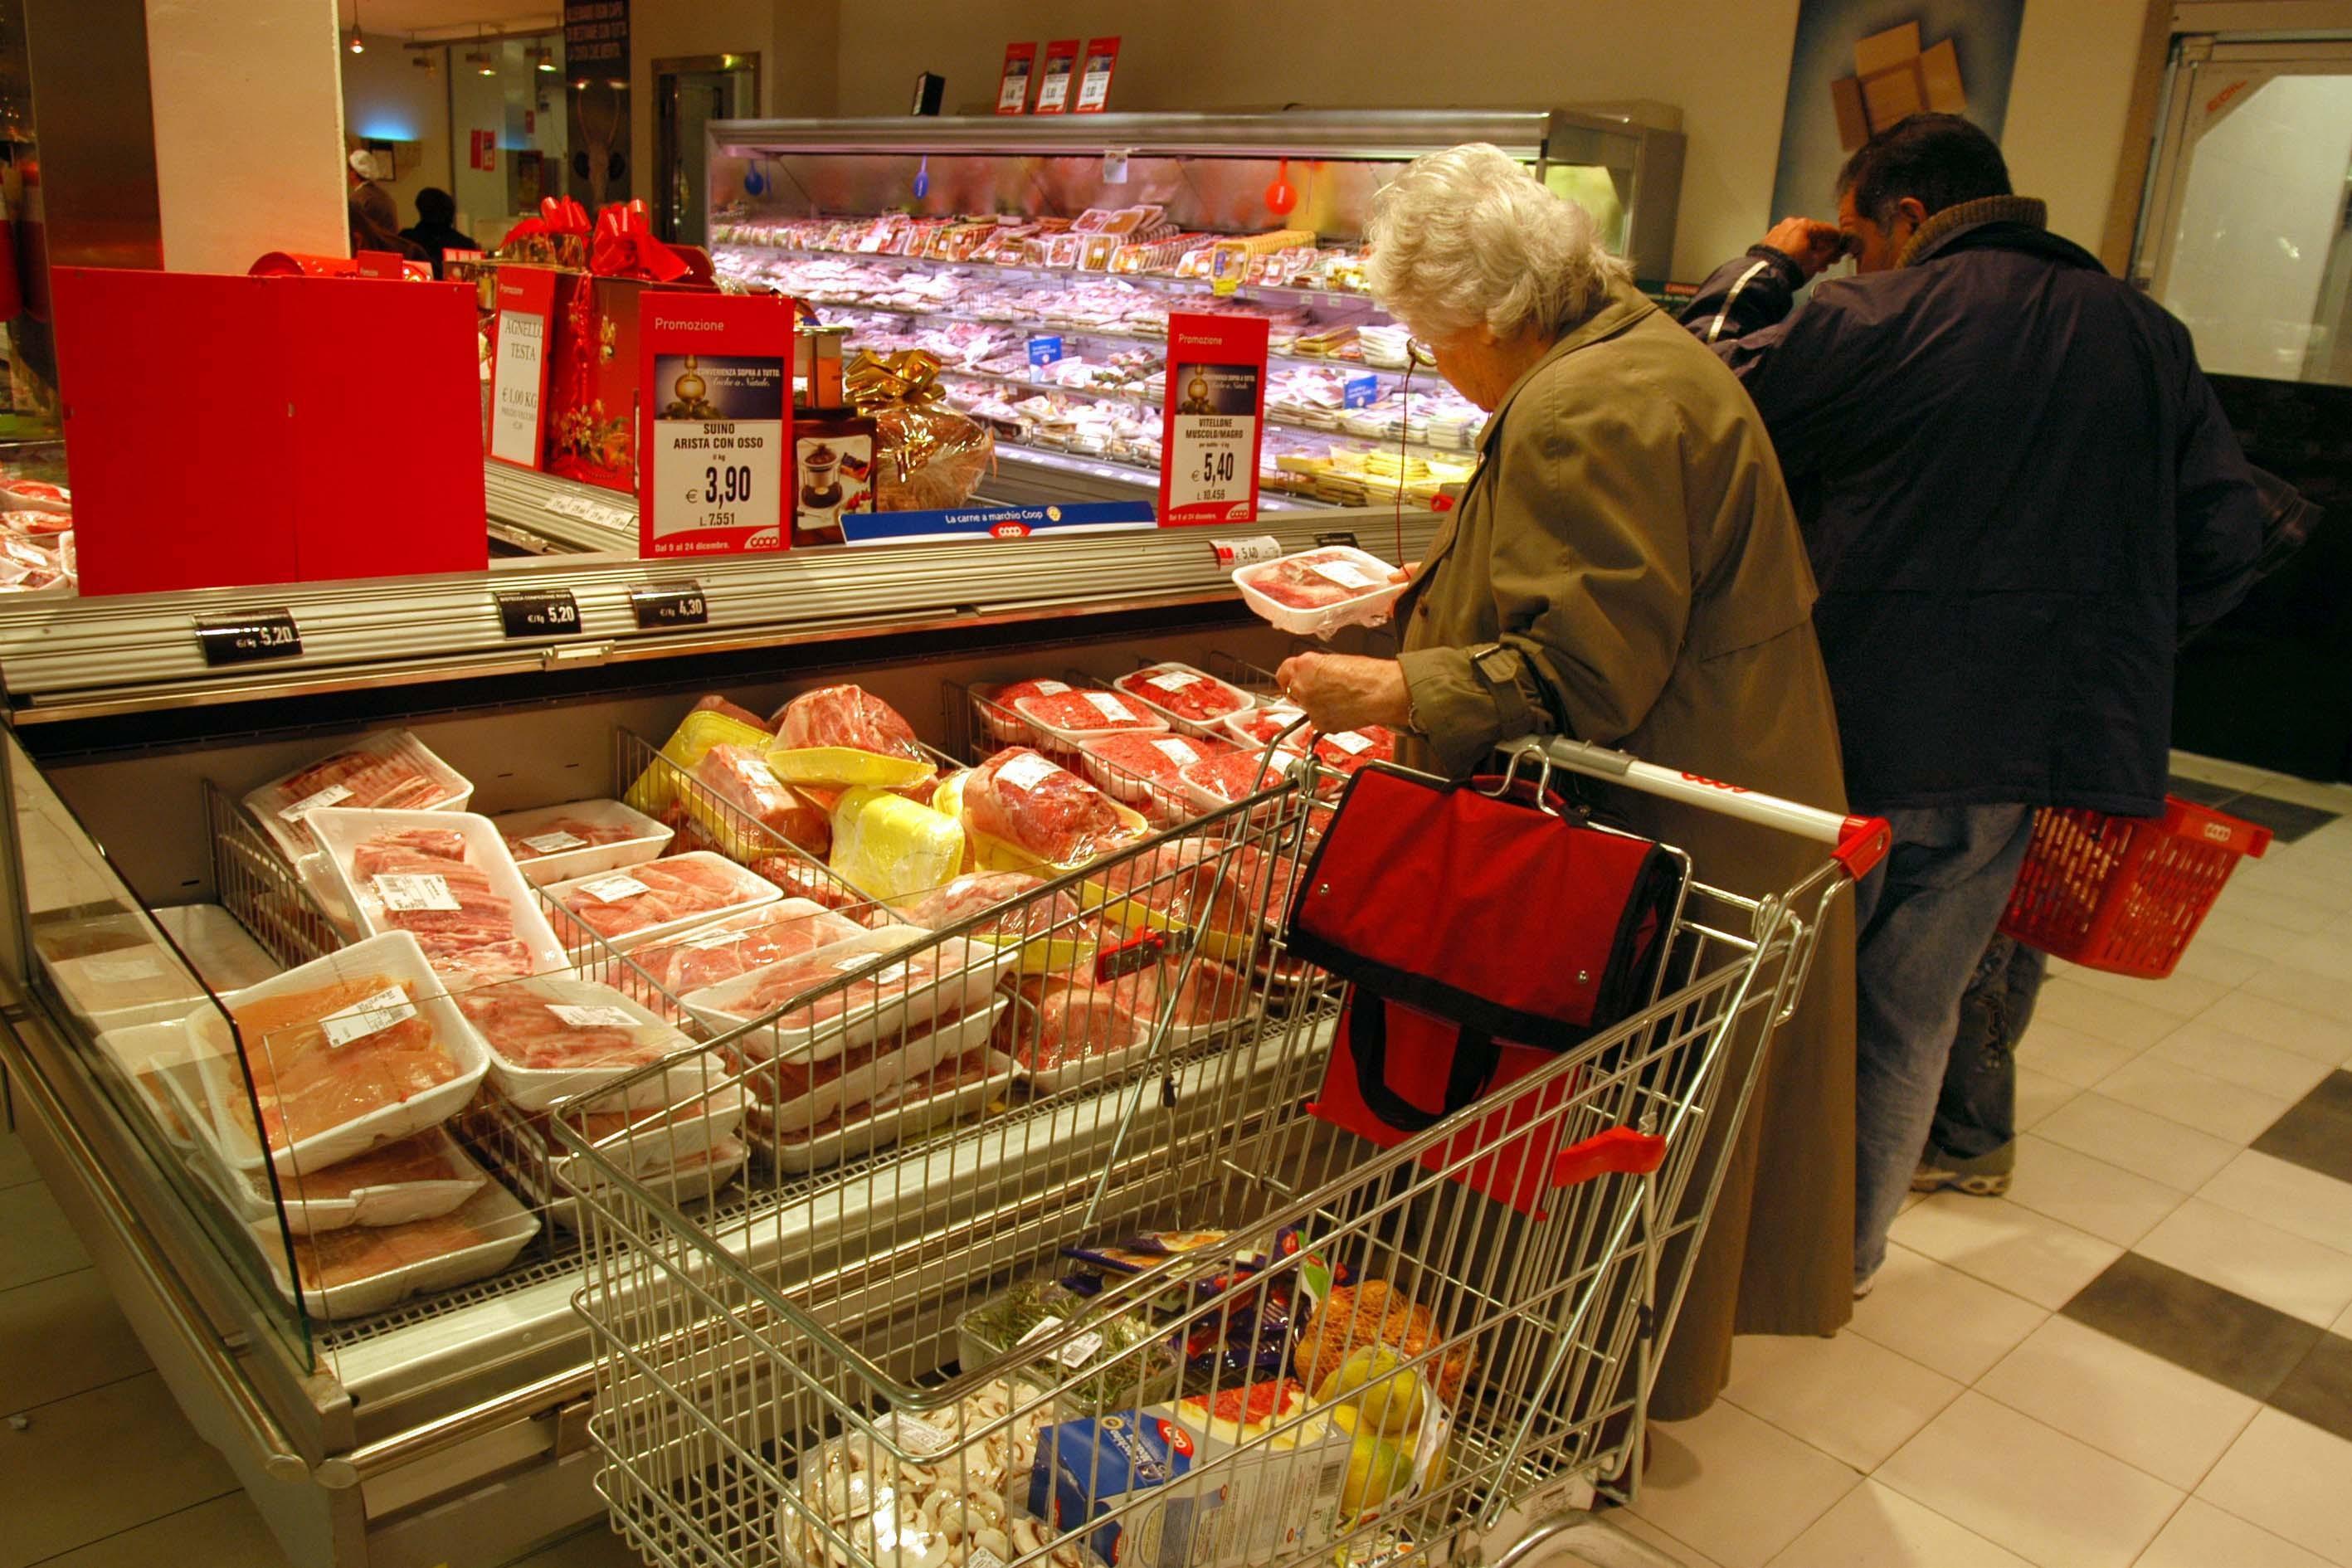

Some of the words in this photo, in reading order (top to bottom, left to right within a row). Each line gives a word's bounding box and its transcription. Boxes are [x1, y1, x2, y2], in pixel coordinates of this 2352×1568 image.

[655, 317, 724, 331] Promozione
[1178, 333, 1223, 345] Promozione
[511, 343, 536, 361] TESTA
[524, 391, 538, 409] KG
[704, 423, 735, 435] SUINO
[1199, 418, 1232, 427] VITELLONE
[674, 438, 710, 450] ARISTA
[713, 438, 734, 449] CON
[738, 437, 763, 449] OSSO
[1191, 470, 1200, 482] €
[1204, 452, 1234, 488] 5,40
[686, 489, 698, 504] €
[705, 465, 751, 509] 3,90
[709, 512, 736, 525] 7.551
[945, 514, 956, 523] La
[957, 514, 981, 523] carne
[988, 511, 1021, 521] marchio
[1021, 510, 1044, 520] Coop
[655, 543, 666, 553] Dal
[669, 543, 674, 552] 9
[675, 543, 683, 552] al
[684, 542, 694, 551] 24
[679, 598, 703, 616] 4,30
[548, 606, 575, 623] 5,20
[261, 626, 293, 645] 5,20
